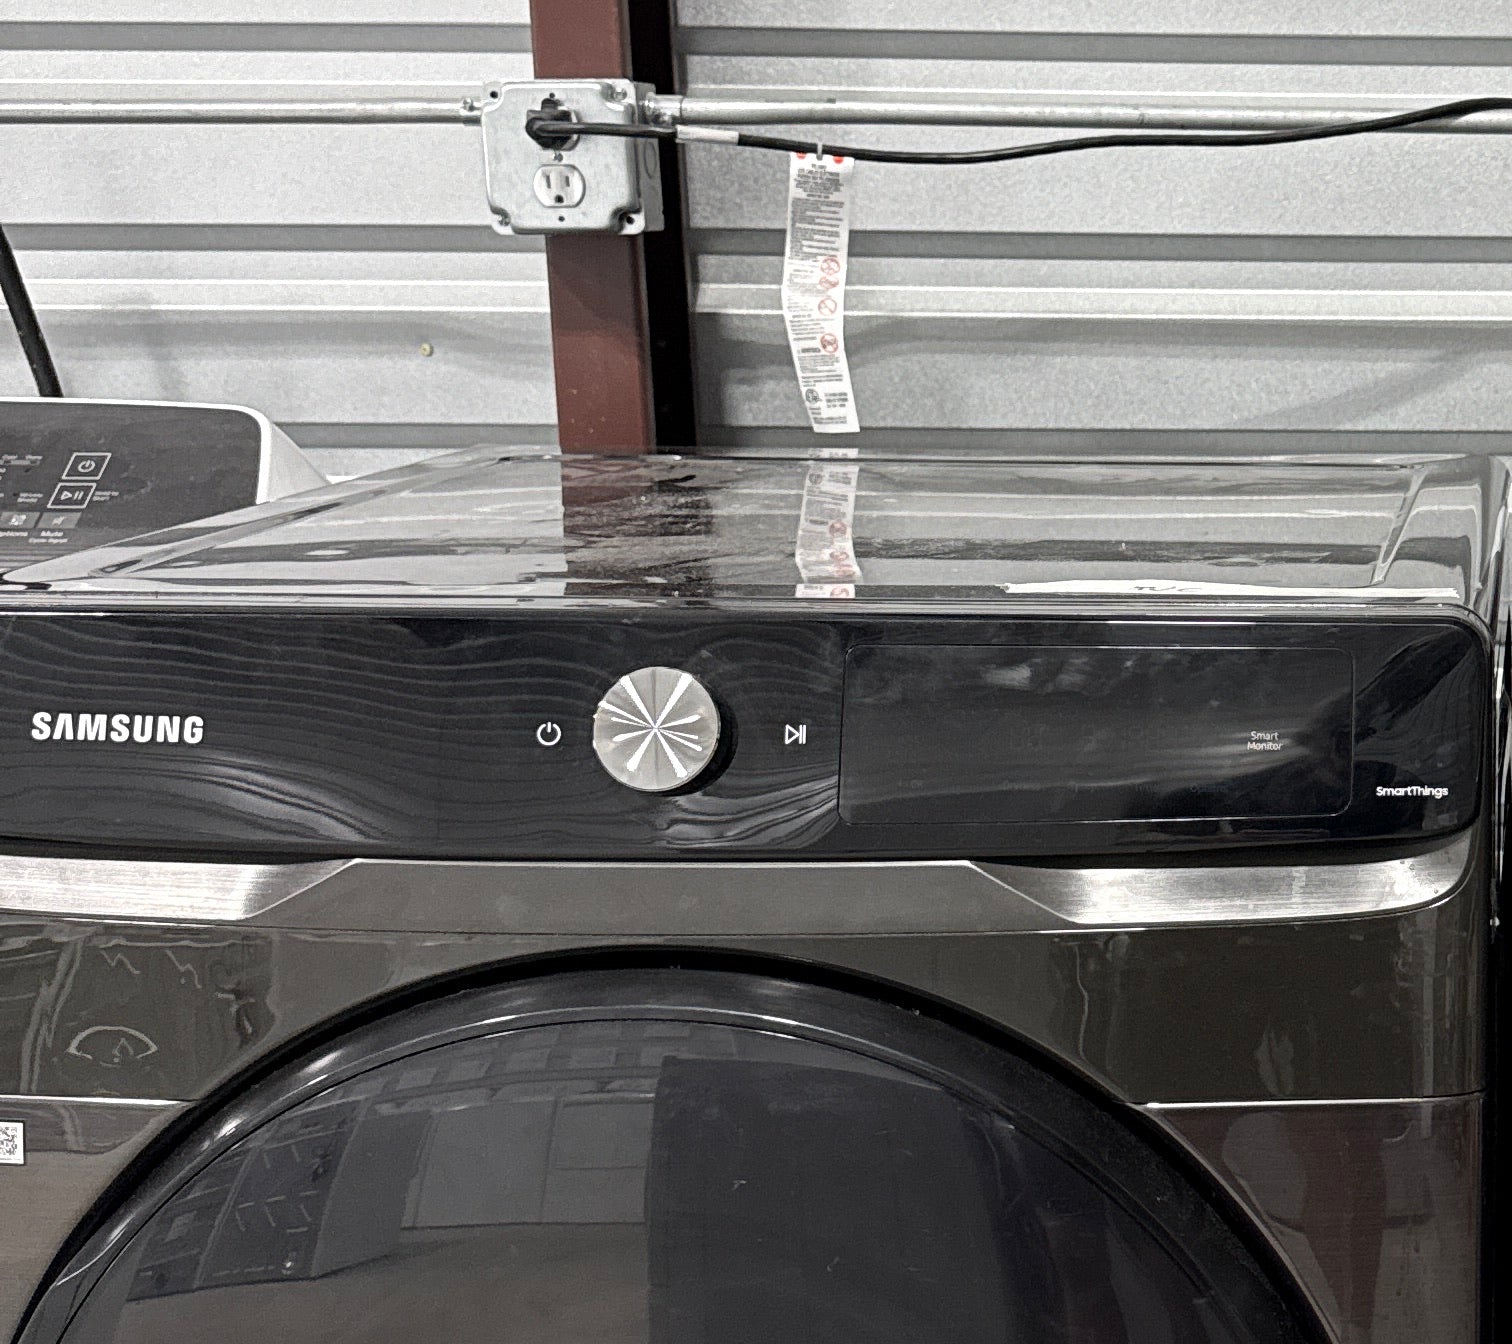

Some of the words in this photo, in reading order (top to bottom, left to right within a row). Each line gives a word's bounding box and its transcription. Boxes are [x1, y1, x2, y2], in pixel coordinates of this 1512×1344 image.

[31, 712, 204, 744] SAMSUNG
[1250, 731, 1279, 741] Smart
[1247, 741, 1284, 751] Monitor
[1376, 786, 1449, 799] SmartThings
